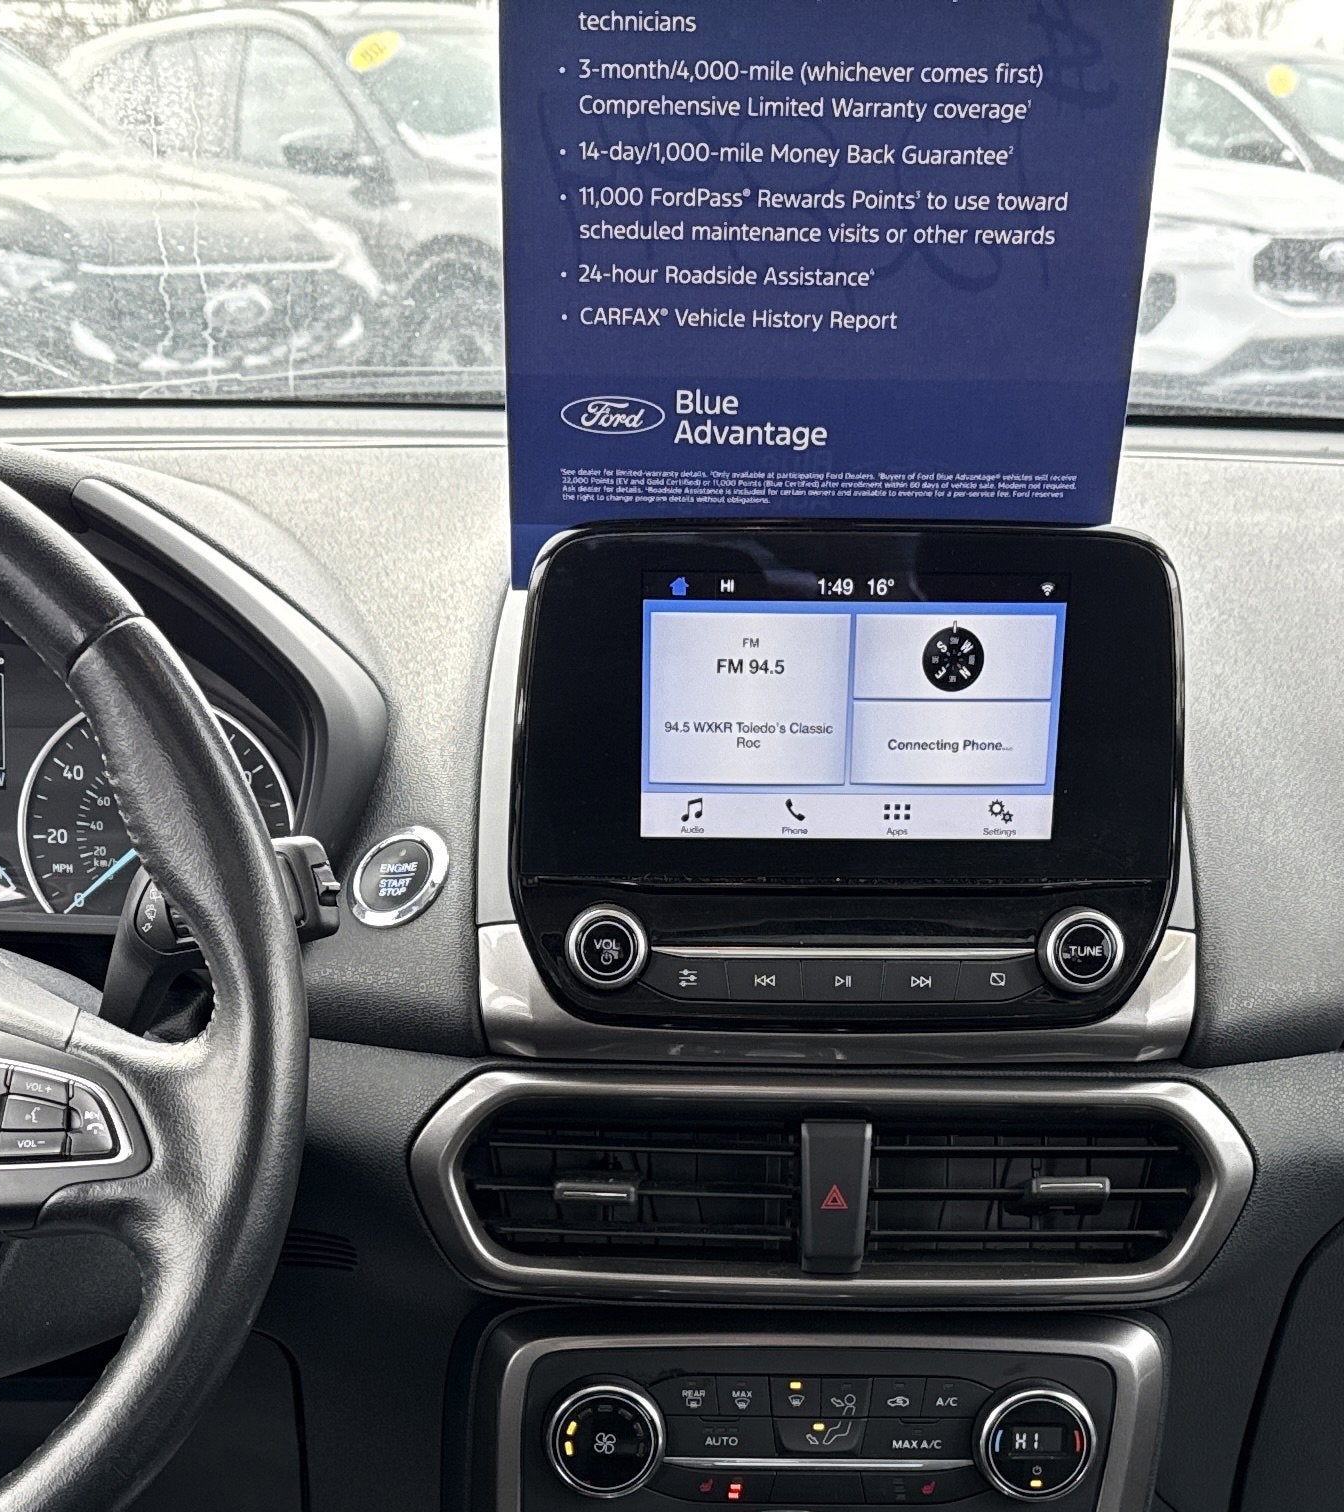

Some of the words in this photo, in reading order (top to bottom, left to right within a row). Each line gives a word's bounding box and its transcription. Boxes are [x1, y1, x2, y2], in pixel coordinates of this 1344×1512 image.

[579, 10, 696, 32] technicians
[579, 59, 793, 82] 3-month/4,000-mile
[801, 61, 914, 85] (whichever
[921, 68, 988, 83] comes
[996, 63, 1043, 87] first)
[580, 95, 740, 118] Comprehensive
[748, 96, 823, 117] Limited
[832, 98, 927, 122] Warranty
[579, 141, 763, 164] 14-day/1,000-mile
[771, 144, 840, 167] Money
[848, 144, 895, 164] Back
[579, 187, 643, 208] 11,000
[758, 189, 845, 208] Rewards
[927, 192, 947, 210] to
[955, 196, 990, 210] use
[997, 192, 1068, 211] toward
[580, 220, 683, 240] scheduled
[692, 222, 821, 242] maintenance
[828, 223, 879, 243] visits
[886, 229, 907, 243] or
[914, 224, 968, 243] other
[975, 226, 1055, 244] rewards
[579, 264, 658, 283] 24-hour
[666, 266, 757, 284] Roadside
[675, 308, 745, 327] Vehicle
[753, 309, 823, 332] History
[831, 311, 897, 332] Report
[677, 389, 738, 414] Blue
[674, 420, 827, 450] Advantage
[721, 580, 734, 592] HI
[818, 578, 853, 595] 1:49
[743, 638, 759, 648] FM
[717, 659, 743, 673] FM
[749, 659, 784, 674] 94.5
[665, 722, 690, 732] 94.5
[693, 722, 732, 733] WXKR
[736, 722, 786, 734] Toledo's
[790, 723, 833, 734] Classic
[737, 737, 760, 748] Roc
[888, 739, 959, 753] Connecting
[63, 765, 84, 781] 40
[681, 826, 704, 834] Audio
[887, 827, 908, 837] Apps
[983, 827, 1016, 837] Settings
[47, 830, 68, 844] 20
[53, 864, 73, 873] MPH
[380, 862, 417, 872] ENGINE
[379, 878, 411, 889] START
[379, 887, 406, 897] STOP
[594, 939, 616, 950] VOL
[1069, 946, 1102, 956] TUNE
[682, 1390, 706, 1398] REAR
[936, 1397, 957, 1406] A/C
[705, 1437, 738, 1445] AUTO
[893, 1440, 918, 1448] MAX
[920, 1440, 941, 1449] A/C
[1016, 1433, 1038, 1449] HI
